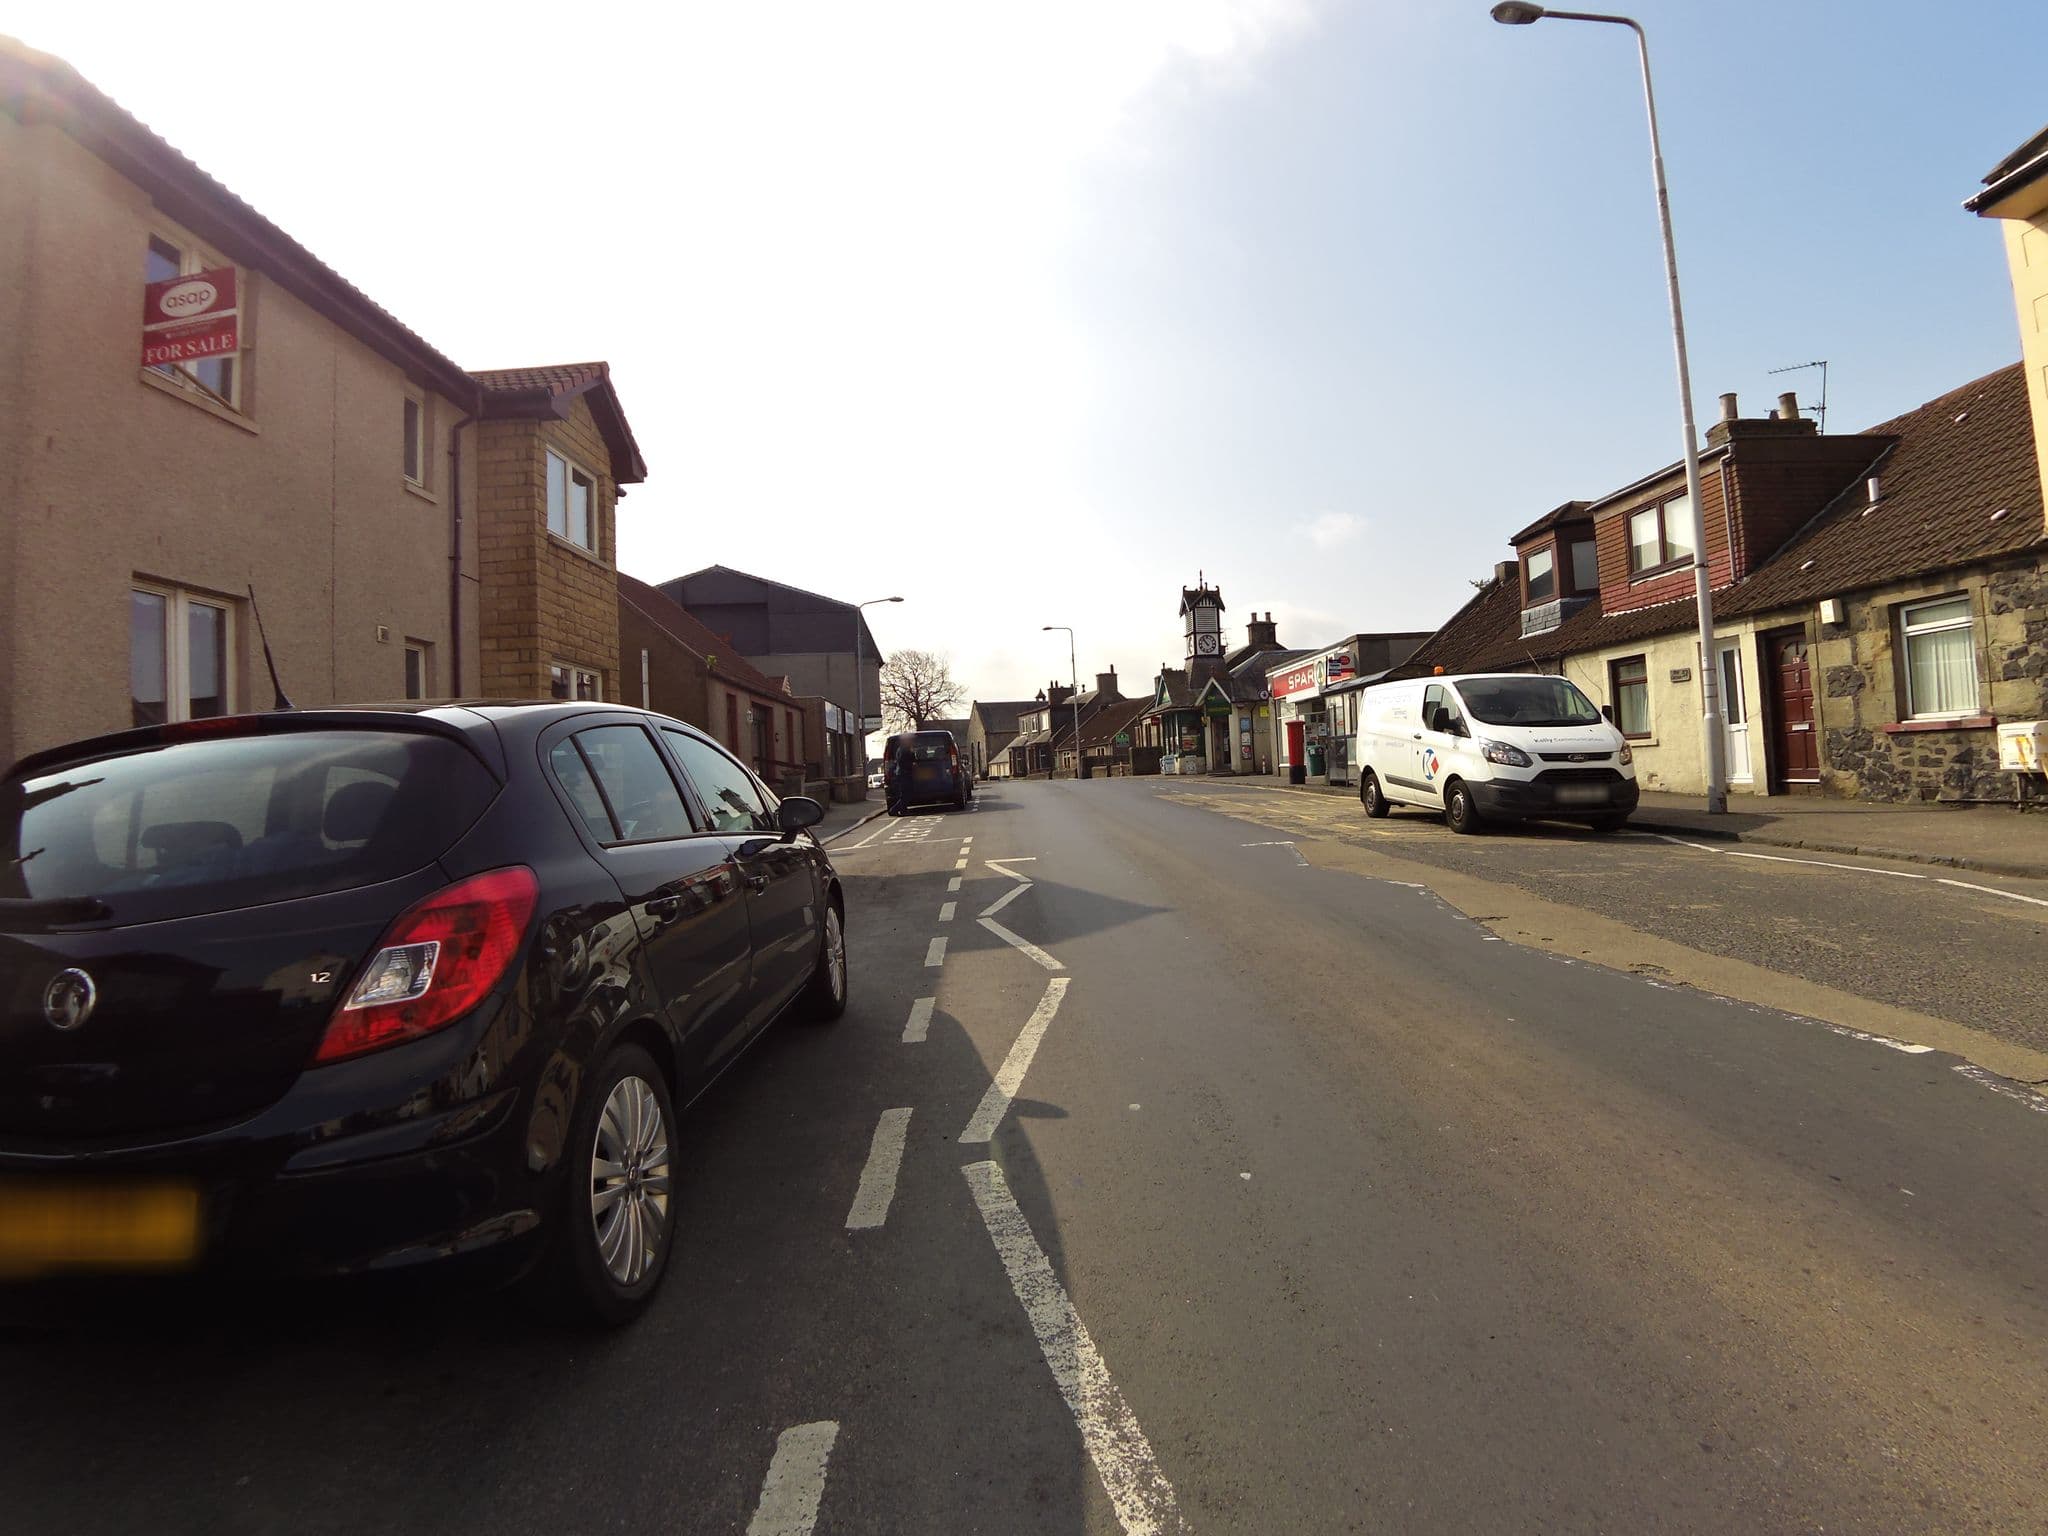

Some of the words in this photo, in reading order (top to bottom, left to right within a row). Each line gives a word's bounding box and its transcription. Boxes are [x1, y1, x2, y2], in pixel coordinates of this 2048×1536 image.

[166, 289, 210, 308] asap
[146, 345, 182, 362] FOR
[186, 334, 232, 355] SALE
[1288, 669, 1315, 690] SPAR
